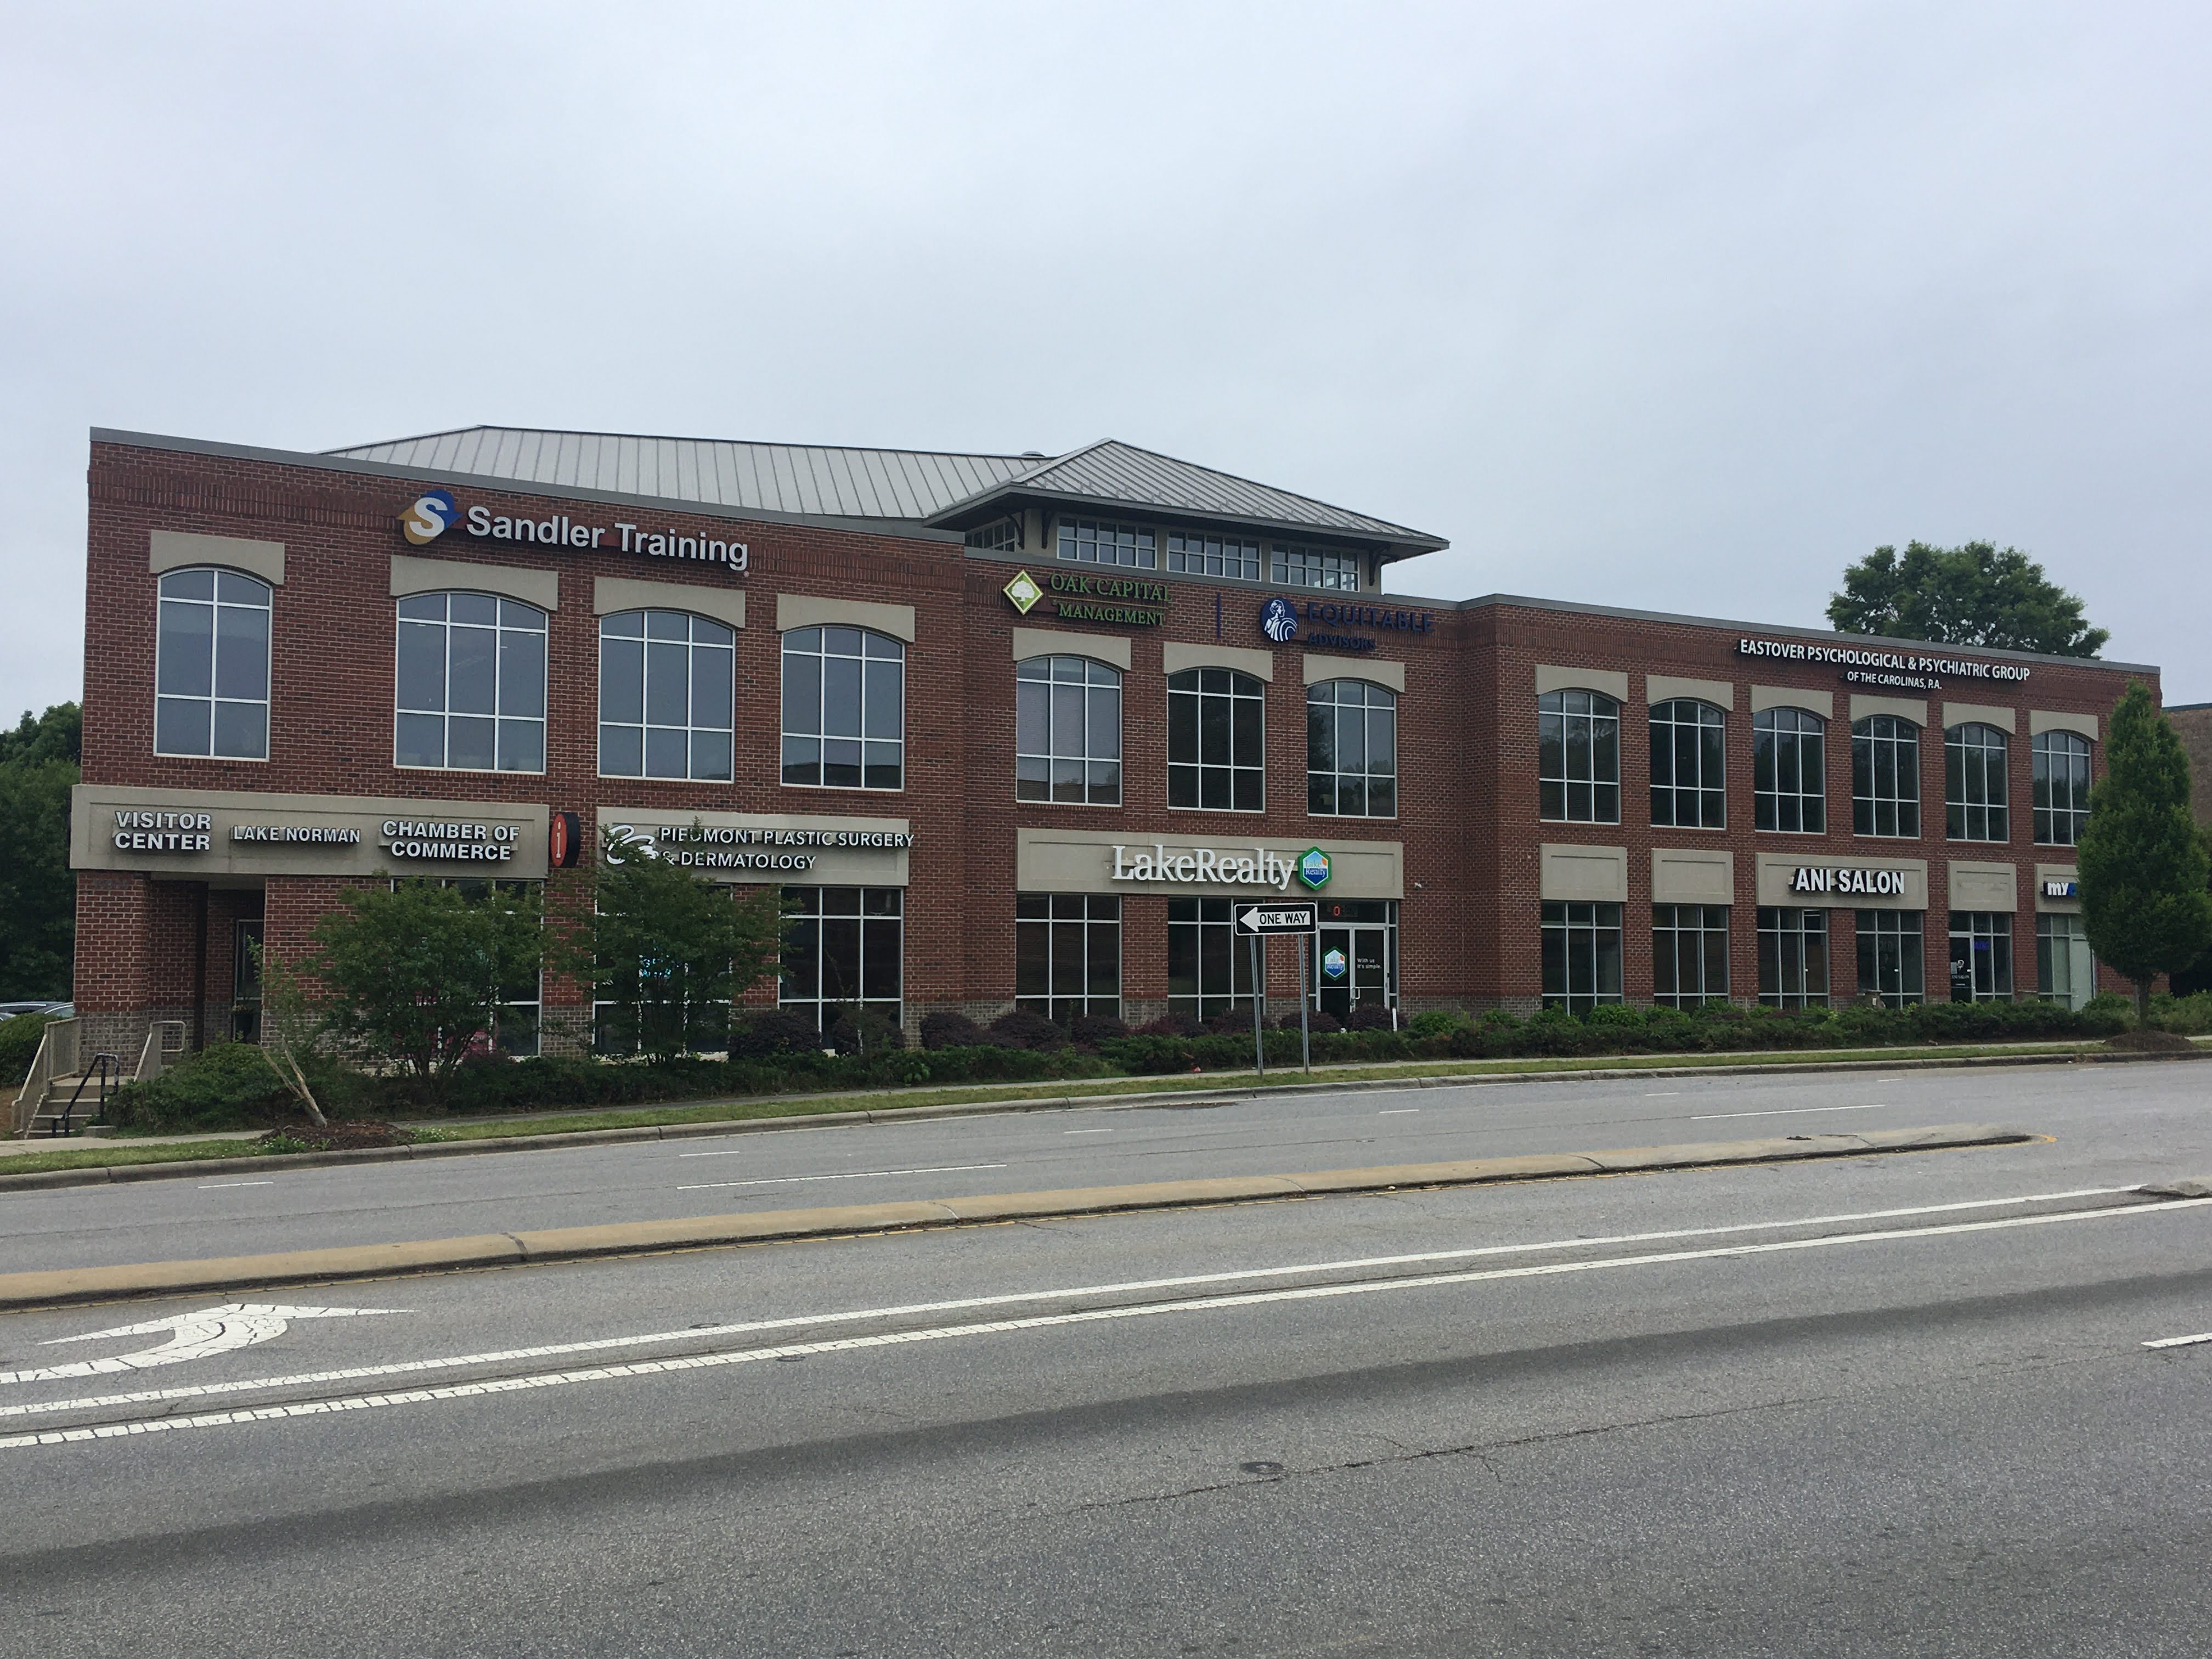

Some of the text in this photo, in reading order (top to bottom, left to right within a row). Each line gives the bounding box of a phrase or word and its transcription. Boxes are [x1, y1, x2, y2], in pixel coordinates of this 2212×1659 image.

[466, 506, 748, 571] Sandler Training
[1051, 573, 1172, 602] OAK CAPITAL
[1058, 603, 1165, 626] MANAGEMENT
[1307, 601, 1436, 632] EQUITABLE
[1308, 632, 1376, 651] ADVISORS
[1740, 639, 2030, 681] EASTOVER PSYCHOLOGICAL & PSYCHIATRIC GROUP
[1847, 671, 1943, 690] OF THE CAROLINAS, P.A.
[115, 811, 211, 830] VISITOR
[233, 826, 360, 842] LAKE NORMAN
[383, 820, 520, 841] CHAMBER OF
[764, 830, 833, 845] PLASTIC
[838, 832, 915, 847] SURGERY
[115, 832, 210, 850] CENTER
[391, 841, 511, 860] COMMERCE
[681, 851, 816, 870] DERMATOLOGY
[1112, 844, 1296, 890] LakeRealty
[1305, 868, 1327, 877] Realty
[1796, 868, 1905, 894] ANI SALON
[1260, 913, 1307, 924] ONE WAY
